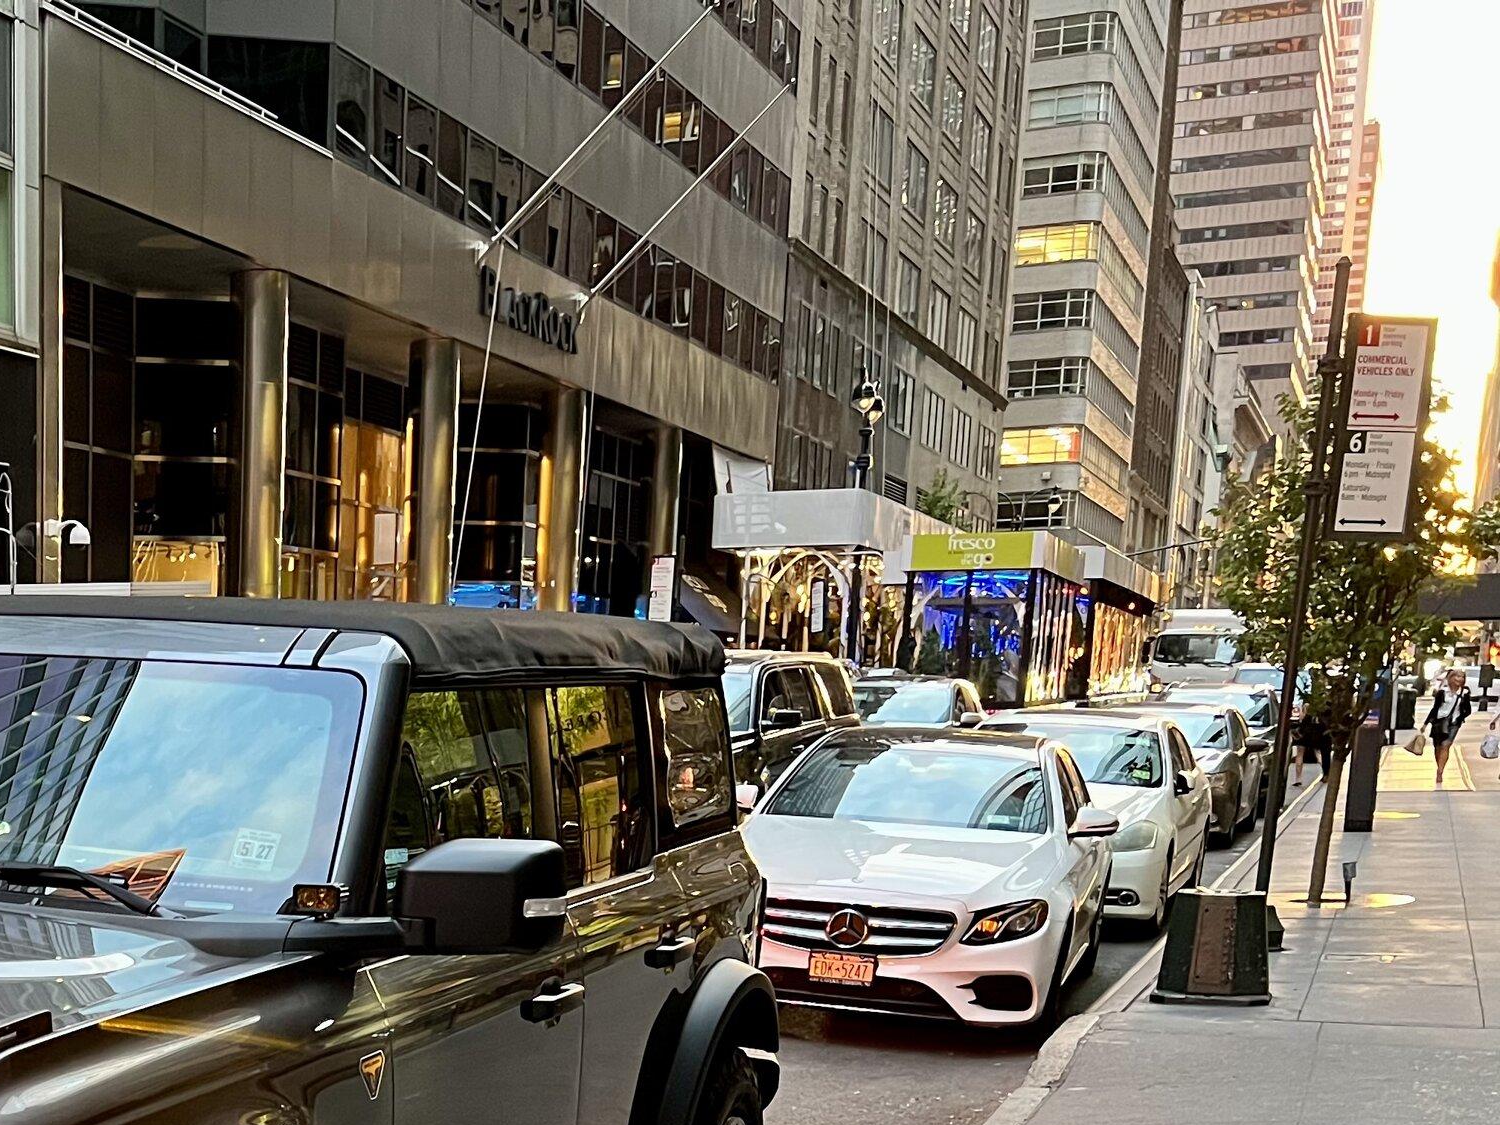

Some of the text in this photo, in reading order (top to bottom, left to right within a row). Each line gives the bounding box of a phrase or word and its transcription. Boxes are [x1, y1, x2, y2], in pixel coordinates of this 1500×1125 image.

[1366, 324, 1373, 345] 1
[1357, 355, 1408, 365] COMMERCIAL
[1357, 366, 1415, 377] VEHICLES ONLY
[1353, 389, 1378, 400] Monday
[1384, 390, 1405, 399] Friday
[1349, 432, 1362, 453] 6
[1345, 461, 1370, 470] Monday
[948, 533, 996, 551] fresco
[973, 553, 995, 569] go
[255, 844, 274, 860] 27
[841, 962, 868, 979] 5247
